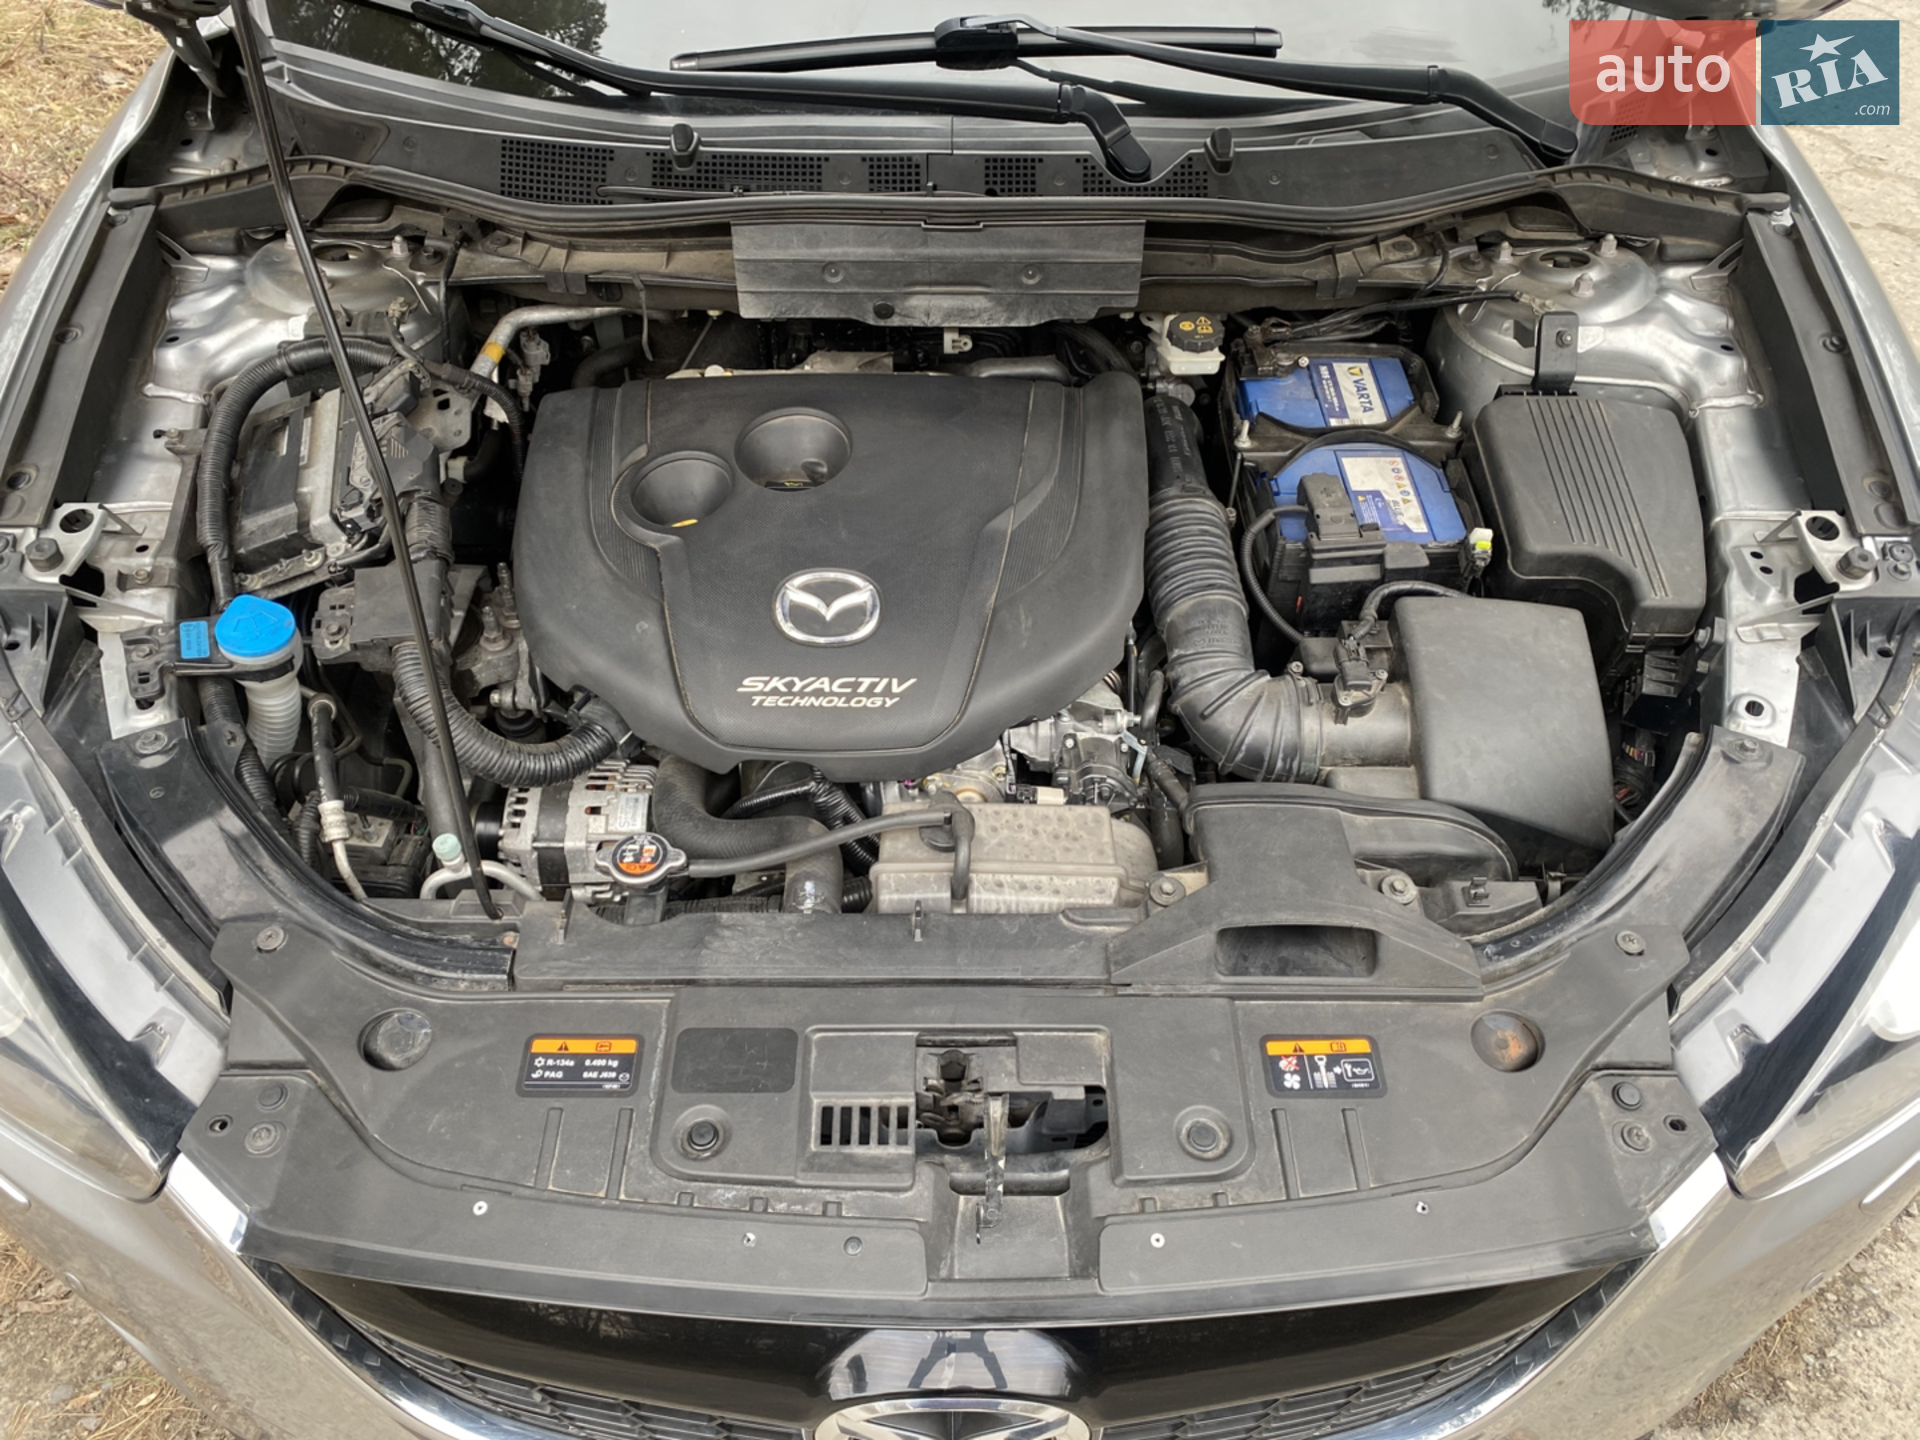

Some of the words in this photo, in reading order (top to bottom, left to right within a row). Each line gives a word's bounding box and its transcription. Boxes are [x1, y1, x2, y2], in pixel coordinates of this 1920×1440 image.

[1353, 378, 1375, 414] VARTA
[736, 676, 918, 693] SKYACTIV
[751, 695, 901, 708] TECHNOLOGY
[546, 1058, 575, 1067] R-134a
[607, 1058, 619, 1068] kg
[543, 1070, 564, 1079] PAG
